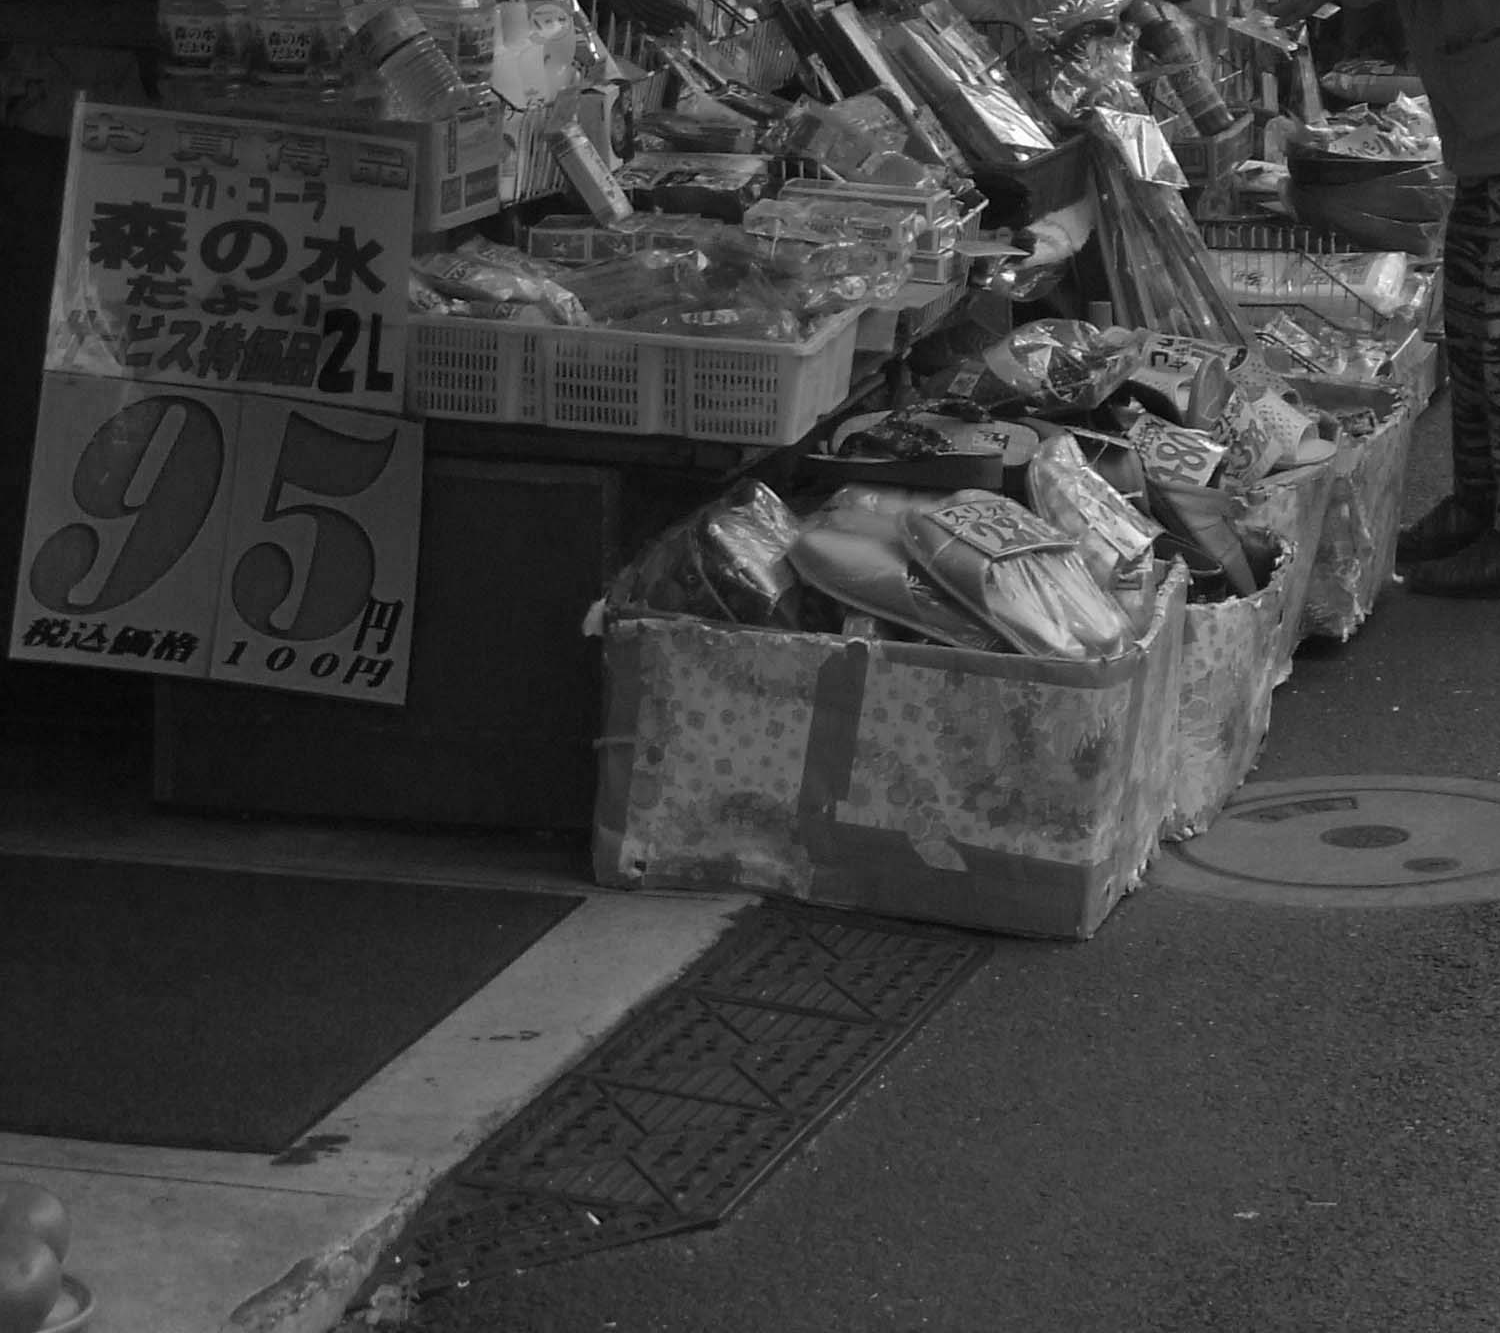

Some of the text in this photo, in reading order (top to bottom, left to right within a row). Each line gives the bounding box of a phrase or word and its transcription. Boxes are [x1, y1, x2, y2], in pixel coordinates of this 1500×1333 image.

[162, 167, 327, 222] コカ・コーラ
[89, 201, 389, 295] 森の水
[318, 308, 396, 393] 2L
[30, 395, 404, 654] 95 円
[23, 617, 200, 664] 税込価格
